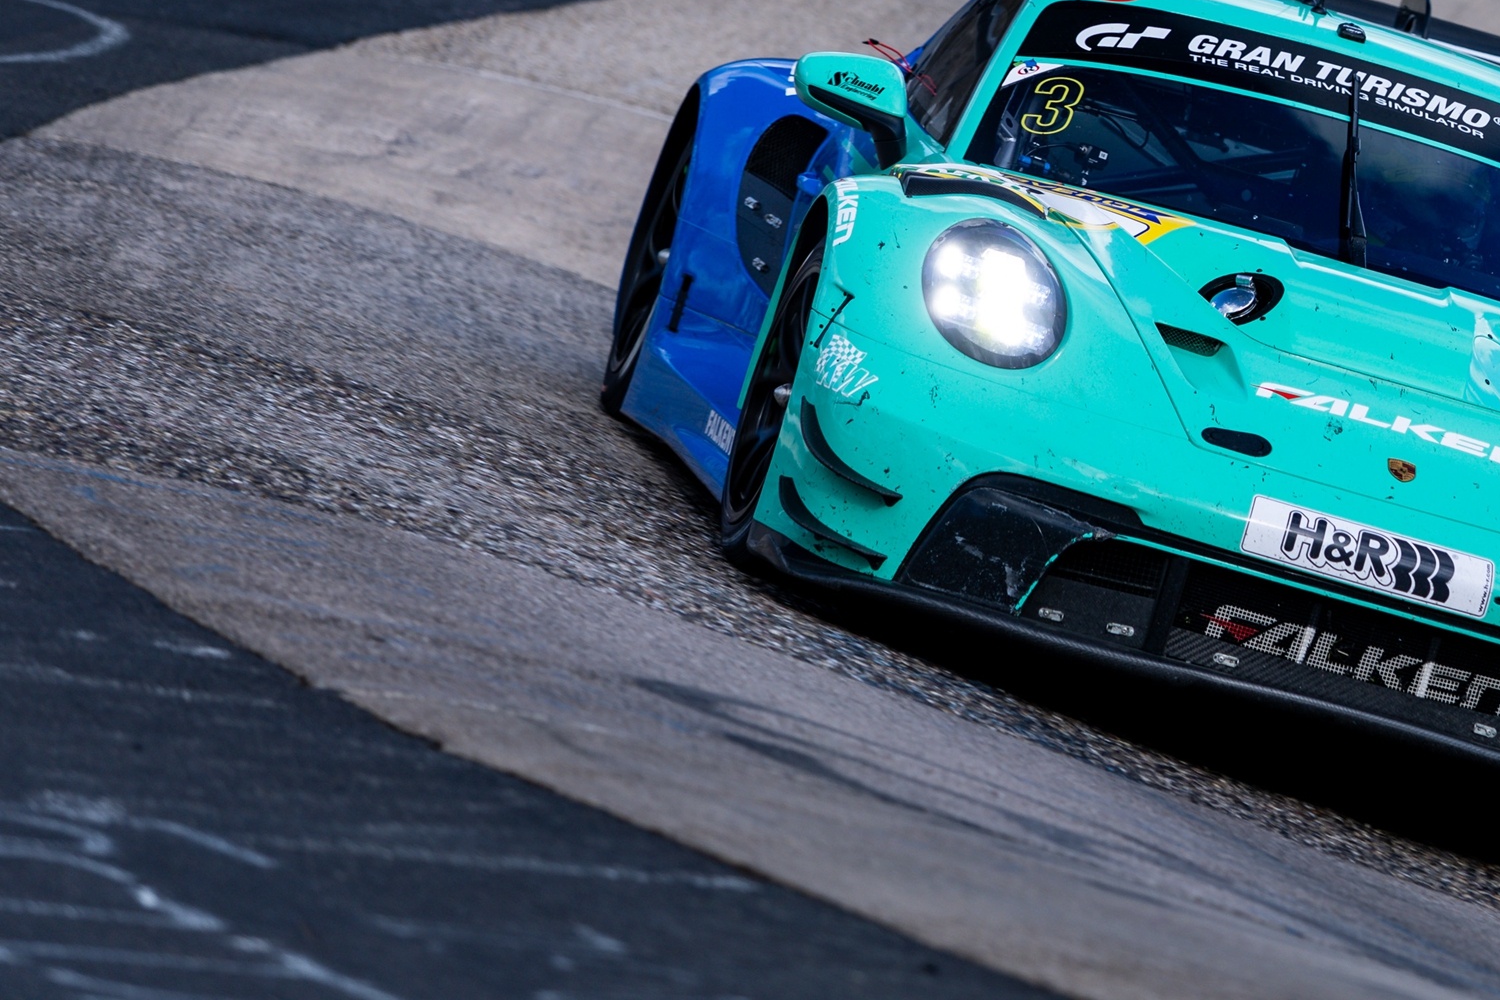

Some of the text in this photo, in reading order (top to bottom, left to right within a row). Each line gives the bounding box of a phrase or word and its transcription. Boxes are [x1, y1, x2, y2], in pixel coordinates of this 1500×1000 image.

[1187, 34, 1306, 73] GRAN
[1020, 76, 1085, 135] 3
[1189, 53, 1229, 68] THE
[1234, 62, 1286, 80] REAL
[1374, 97, 1485, 140] SIMULATOR
[1282, 510, 1391, 580] H&R
